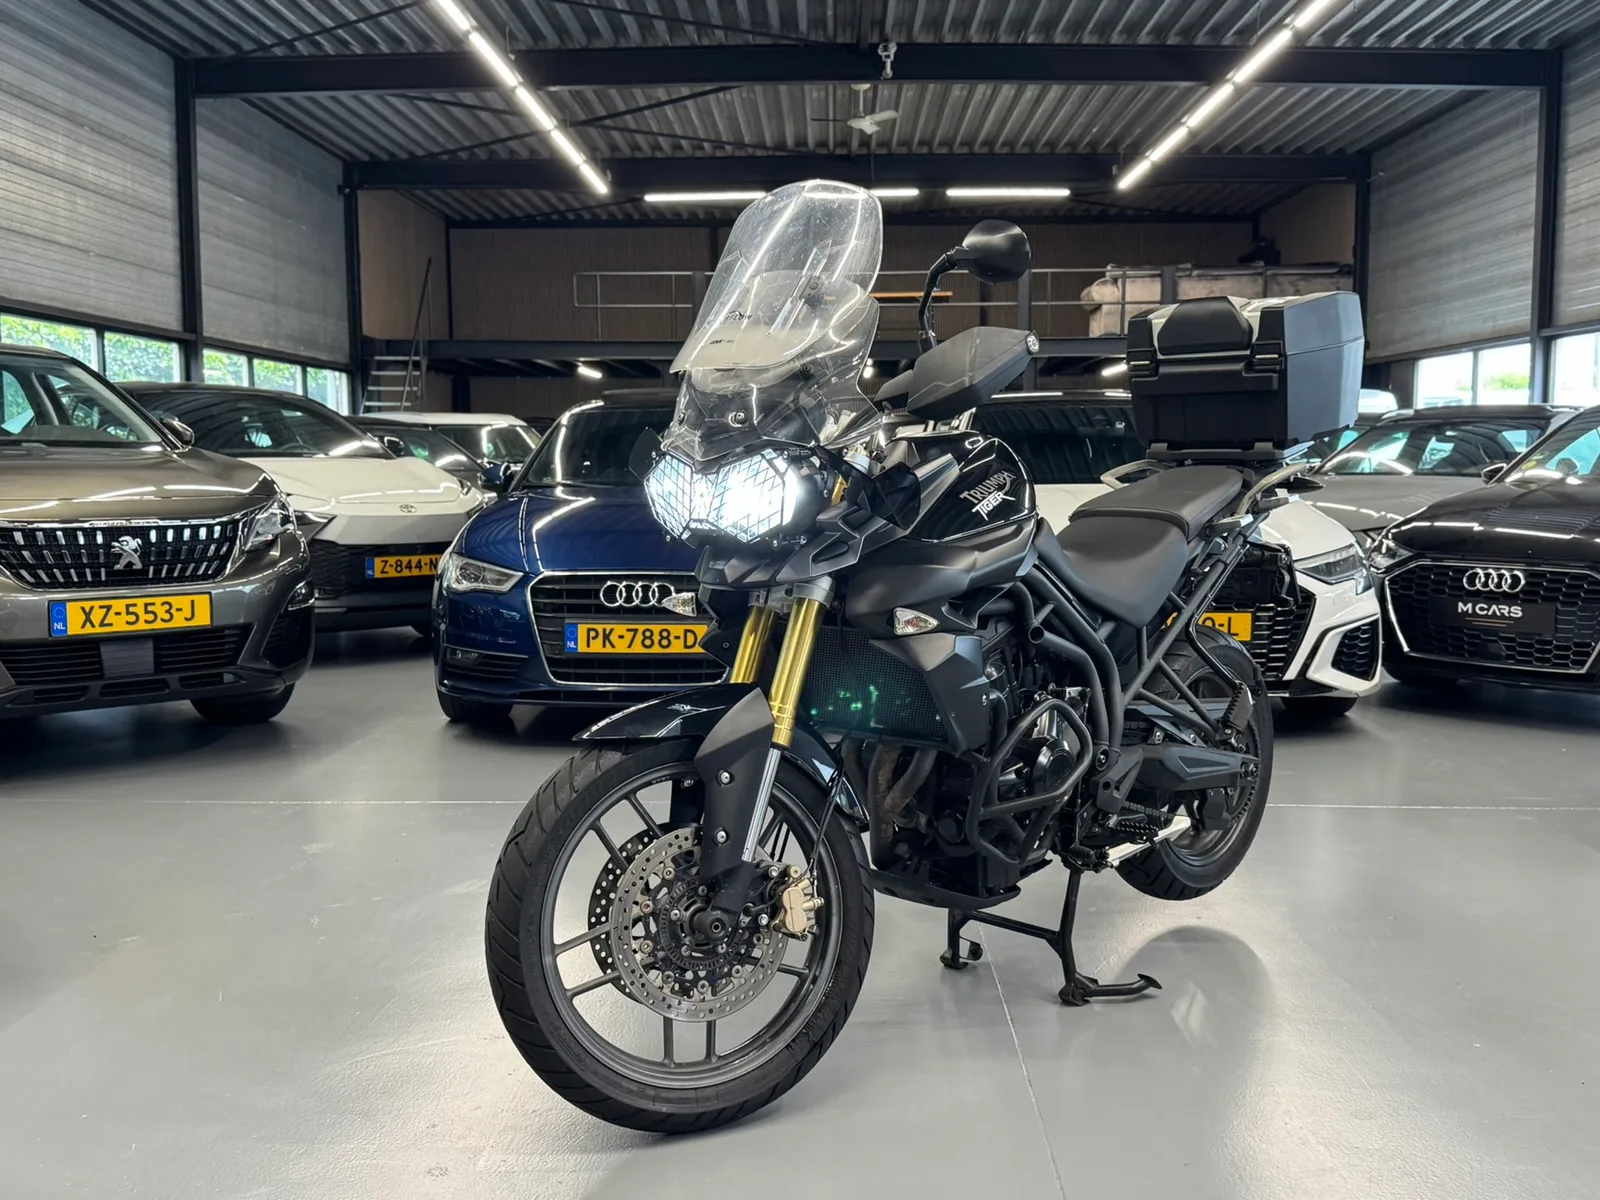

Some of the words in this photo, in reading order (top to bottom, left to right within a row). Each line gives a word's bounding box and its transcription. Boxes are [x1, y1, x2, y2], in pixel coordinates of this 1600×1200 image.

[959, 470, 1017, 504] TRIUMPH
[971, 490, 1016, 521] TIGER
[80, 599, 196, 629] XZ-553-J
[1457, 601, 1473, 614] M
[1475, 603, 1523, 618] CARS
[54, 622, 66, 630] NL
[566, 640, 577, 649] NL
[586, 627, 698, 650] PK-788-D
